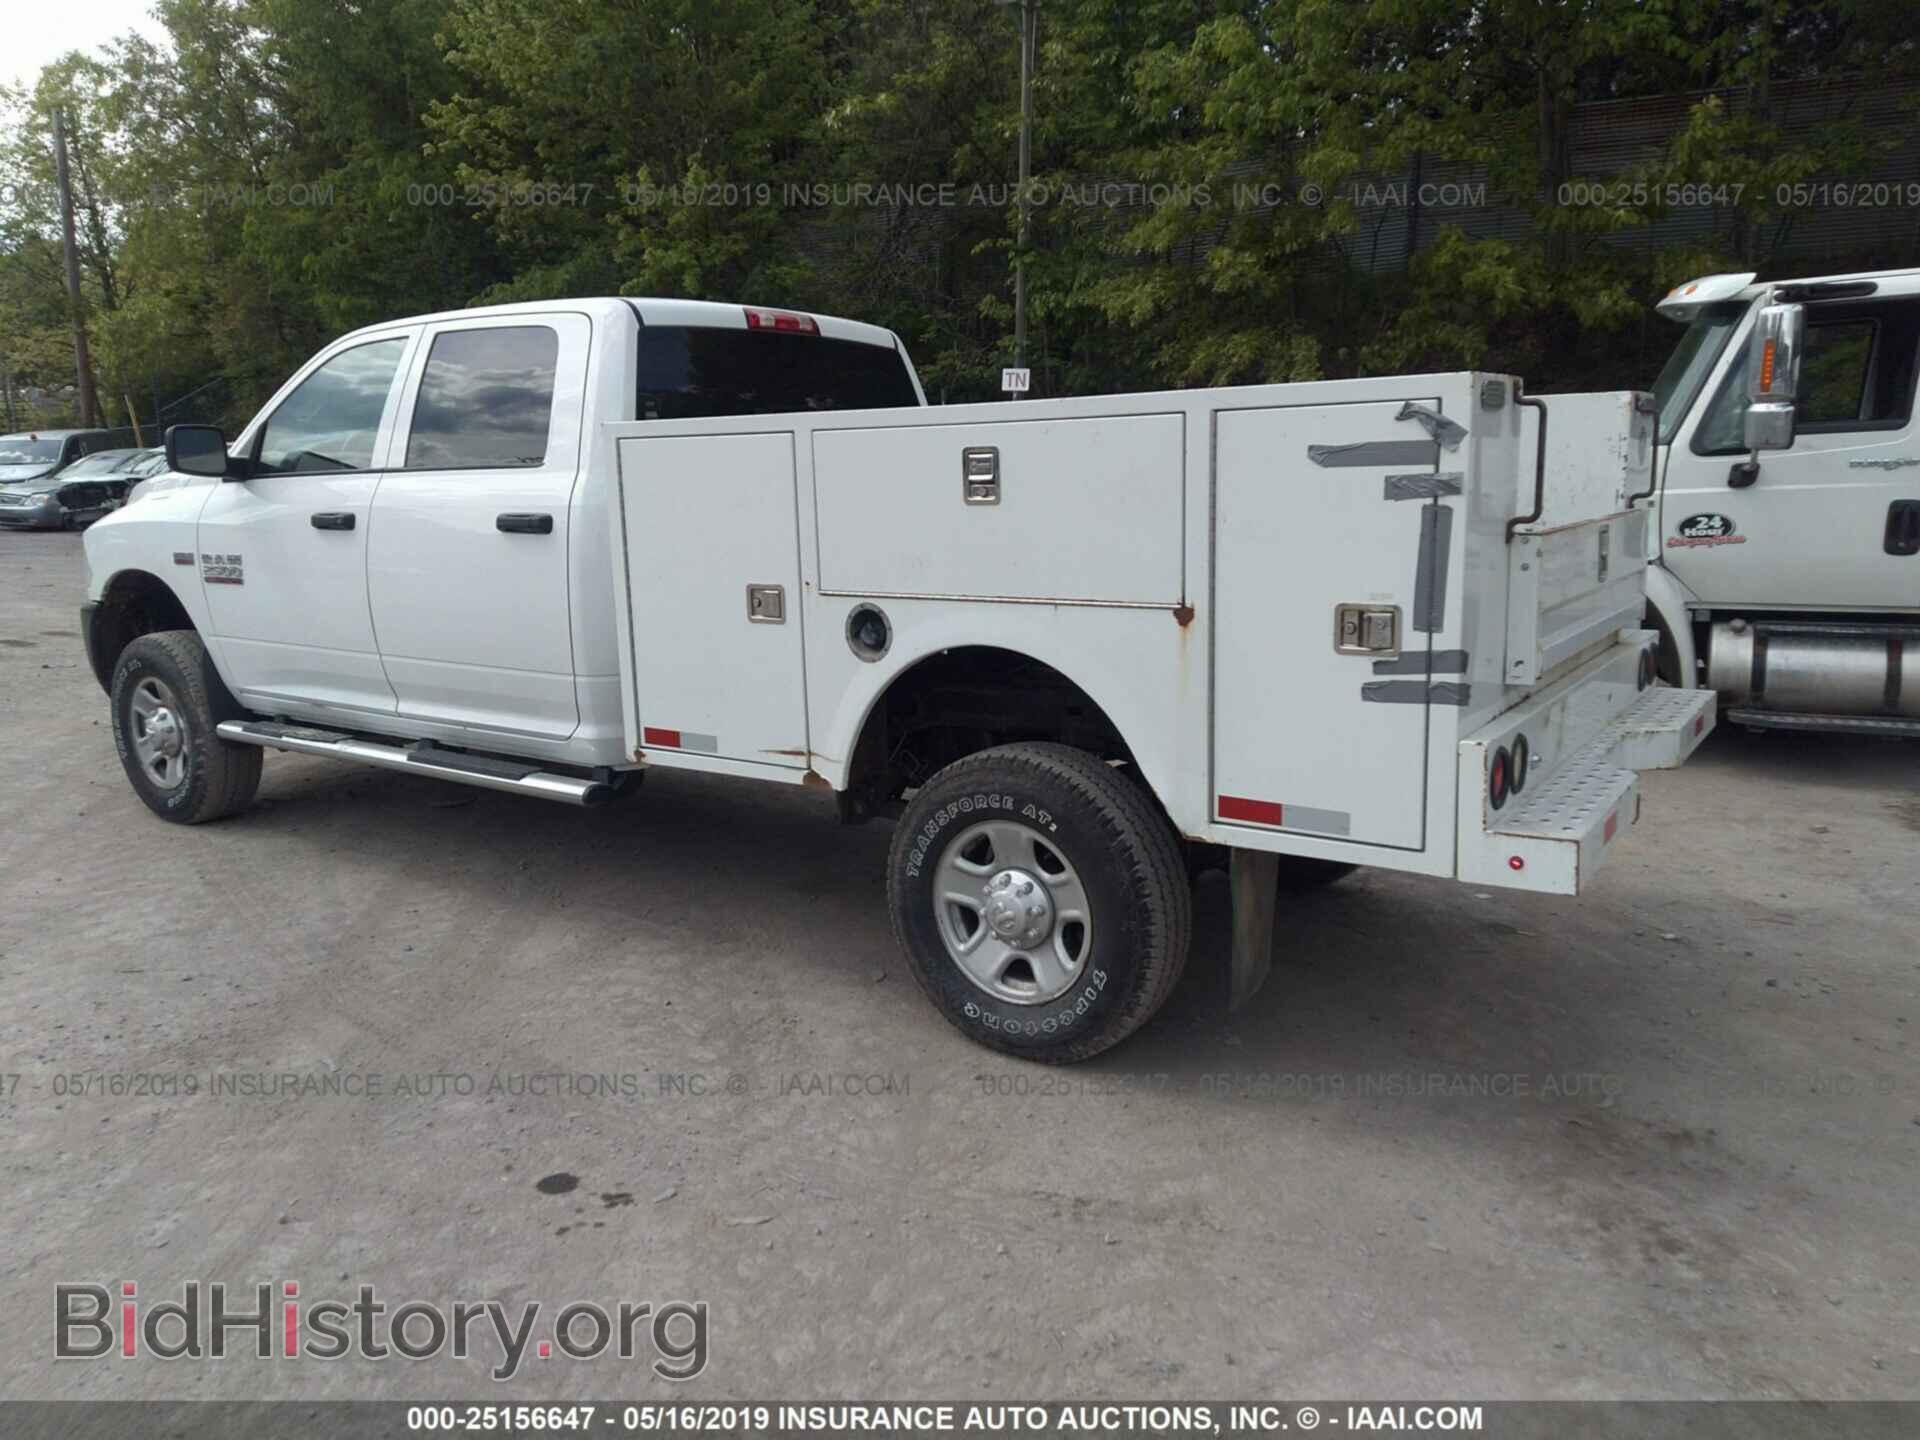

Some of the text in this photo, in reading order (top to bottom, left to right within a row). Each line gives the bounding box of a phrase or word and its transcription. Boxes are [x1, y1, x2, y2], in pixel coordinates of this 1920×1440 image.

[1005, 372, 1026, 388] TN
[1696, 515, 1723, 529] 24
[905, 794, 1015, 877] TRANSFORCE
